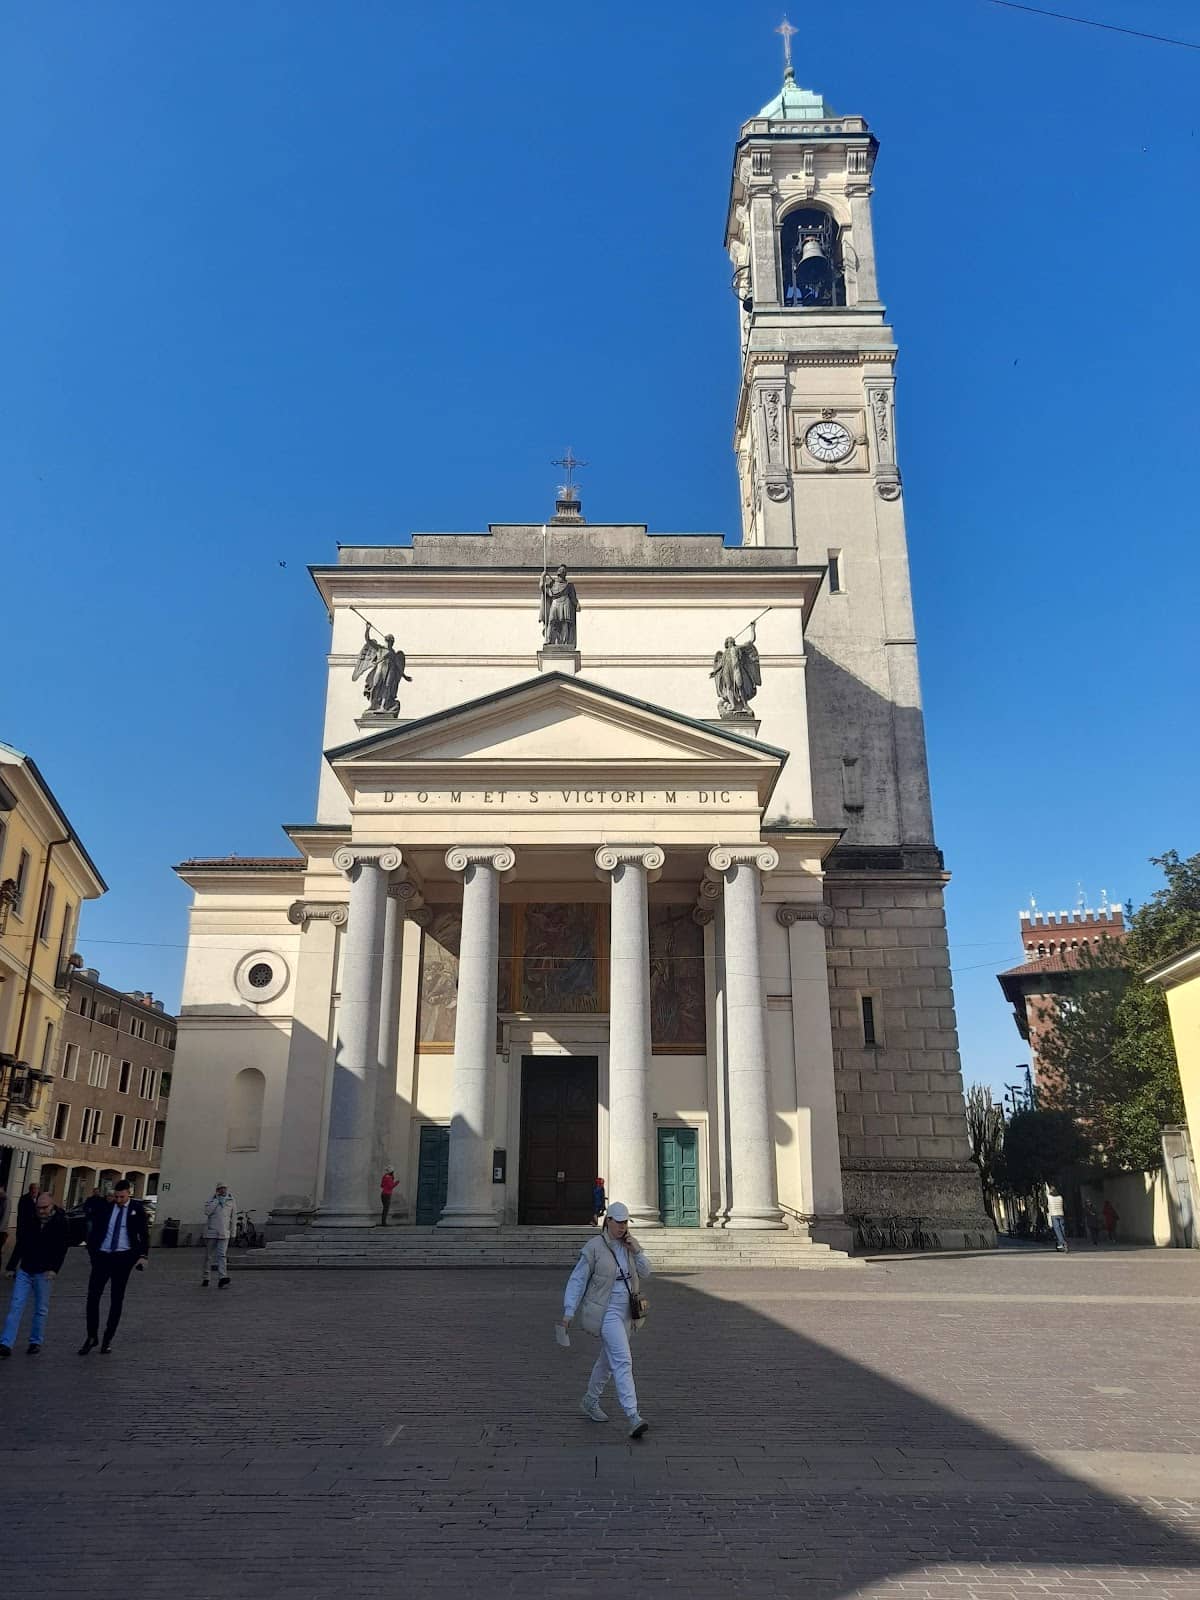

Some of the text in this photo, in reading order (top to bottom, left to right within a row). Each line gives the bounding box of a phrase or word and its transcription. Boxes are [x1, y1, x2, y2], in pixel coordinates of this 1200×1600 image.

[384, 791, 730, 803] D O M ET S VICTORI M DIC
